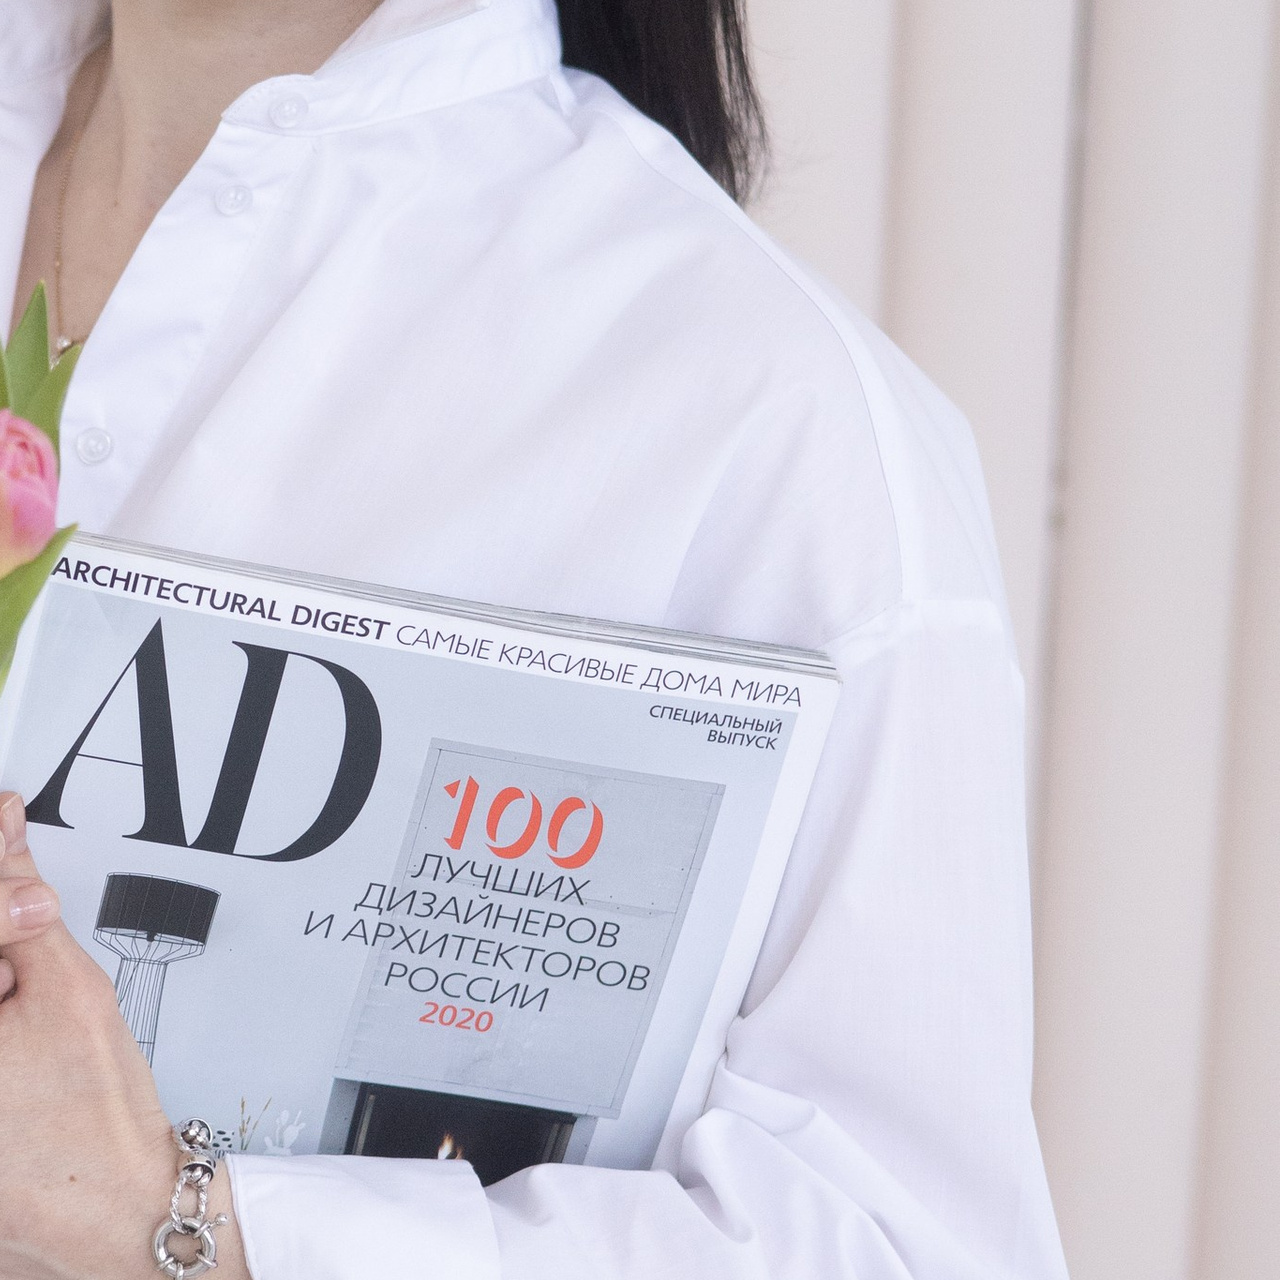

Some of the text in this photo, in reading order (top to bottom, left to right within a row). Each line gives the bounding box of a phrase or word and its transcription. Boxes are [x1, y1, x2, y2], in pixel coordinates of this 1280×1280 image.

[50, 556, 391, 640] ARCHITECTURAL DIGEST
[396, 624, 802, 708] САМЫЕ КРАСИВЫЕ ДОМА МИРА
[25, 616, 383, 863] AD
[649, 704, 783, 734] СПЕЦИАЛЬНЫЙ
[707, 729, 778, 751] ВЫПУСК
[442, 775, 605, 870] 100
[411, 853, 592, 906] ЛУЧШИХ
[354, 882, 621, 949] ДИЗАЙНЕРОВ
[303, 909, 652, 992] И АРХИТЕКТОРОВ
[383, 961, 550, 1013] РОССИИ
[418, 1001, 494, 1033] 2020
